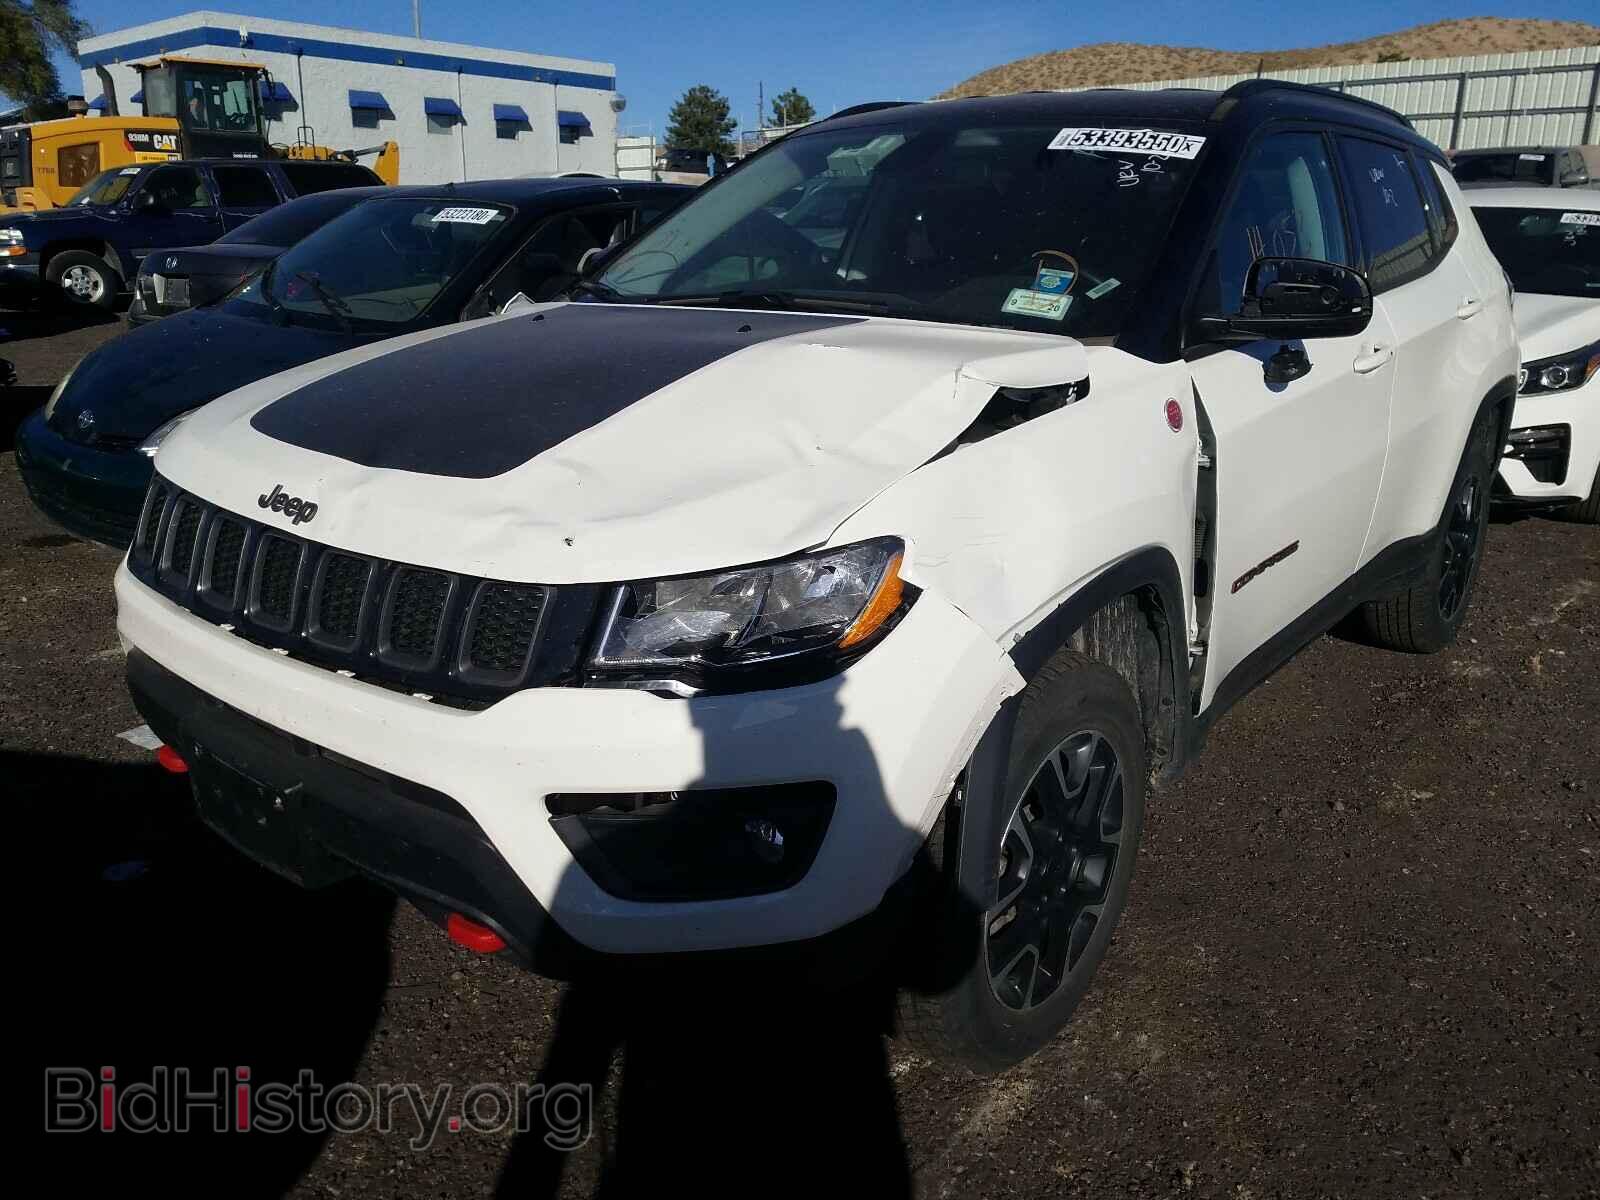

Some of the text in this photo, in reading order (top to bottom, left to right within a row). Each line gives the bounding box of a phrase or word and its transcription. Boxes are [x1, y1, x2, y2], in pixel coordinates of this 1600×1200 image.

[153, 134, 177, 150] CAT
[1070, 129, 1182, 152] 53393550
[1010, 298, 1018, 306] 9
[1047, 303, 1061, 312] 20
[258, 484, 318, 525] Jeep
